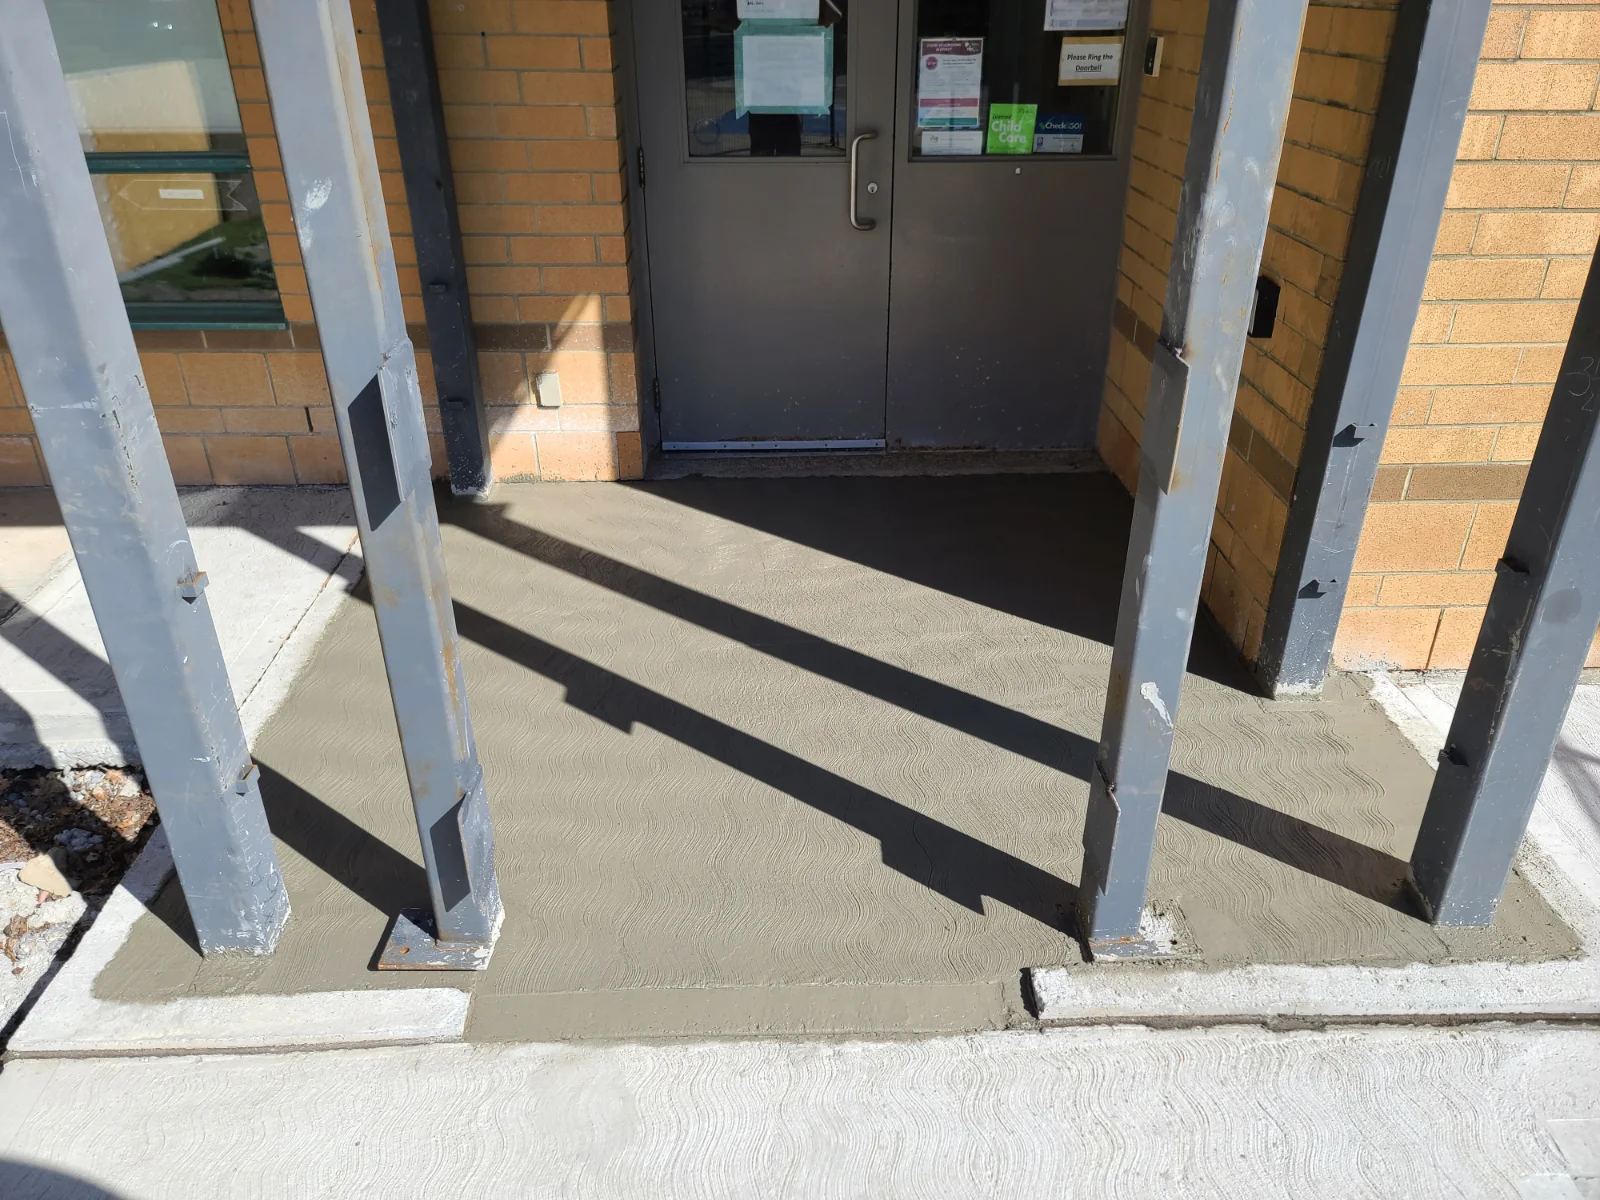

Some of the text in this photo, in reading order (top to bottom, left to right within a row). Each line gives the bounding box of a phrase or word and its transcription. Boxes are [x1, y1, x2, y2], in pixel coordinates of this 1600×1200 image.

[1067, 53, 1114, 62] Please Ring the
[1075, 64, 1103, 72] Doorbell
[991, 120, 1023, 133] Child
[998, 132, 1027, 144] Care
